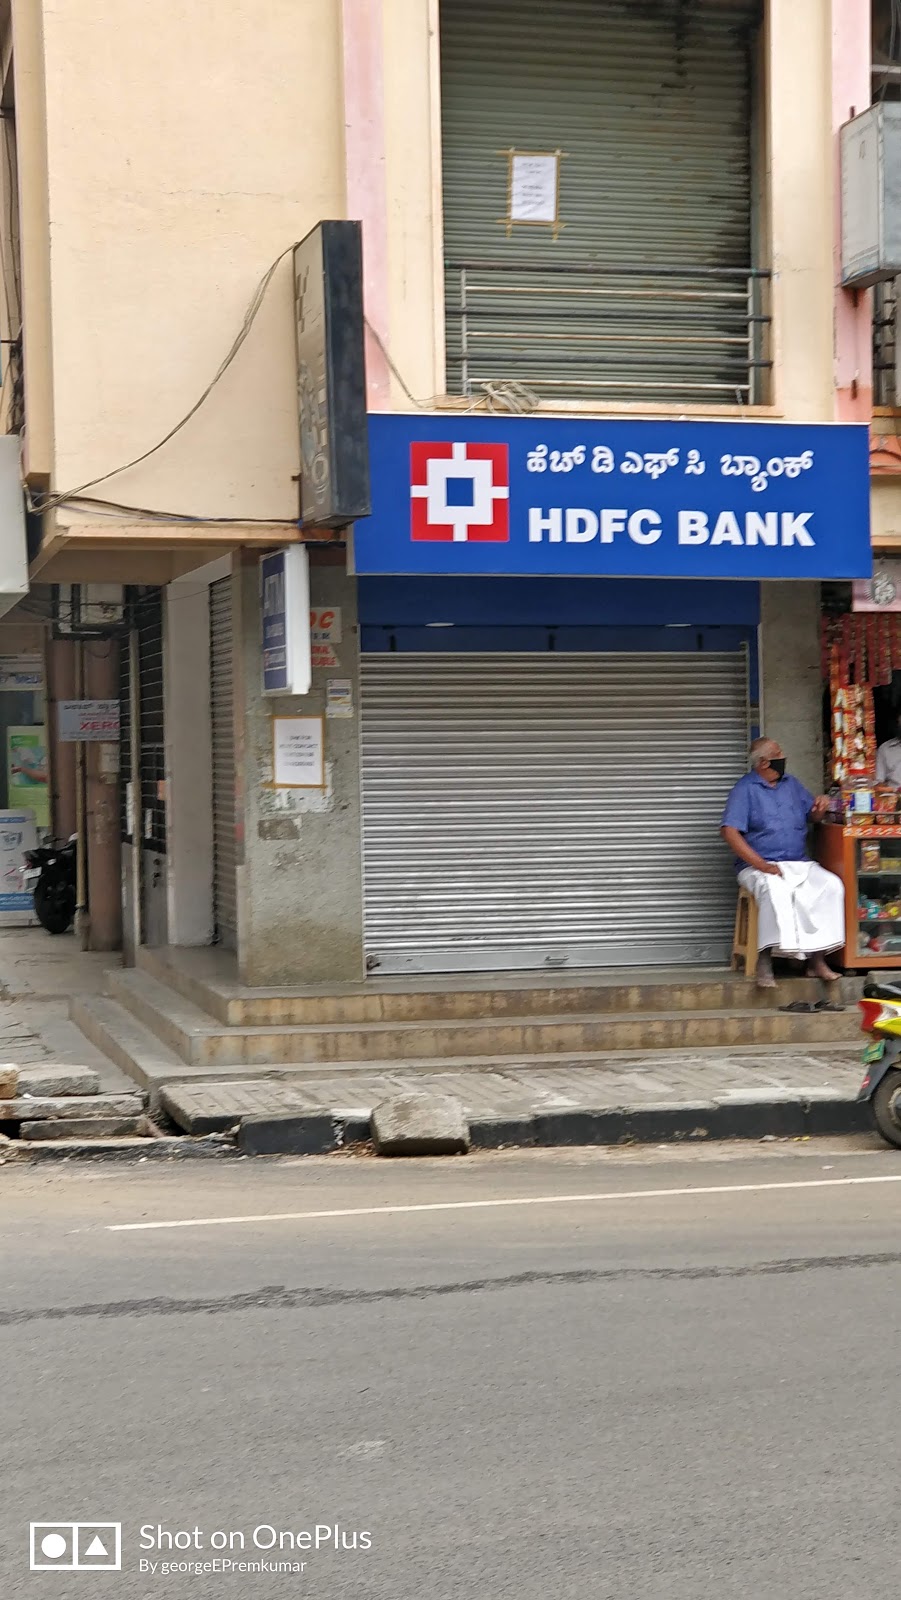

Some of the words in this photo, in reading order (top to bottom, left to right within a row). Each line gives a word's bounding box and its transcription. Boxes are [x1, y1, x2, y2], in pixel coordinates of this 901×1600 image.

[720, 450, 814, 492] ಬ್ಯಾಂಕ್
[528, 507, 663, 545] HDFC
[677, 510, 816, 547] BANK
